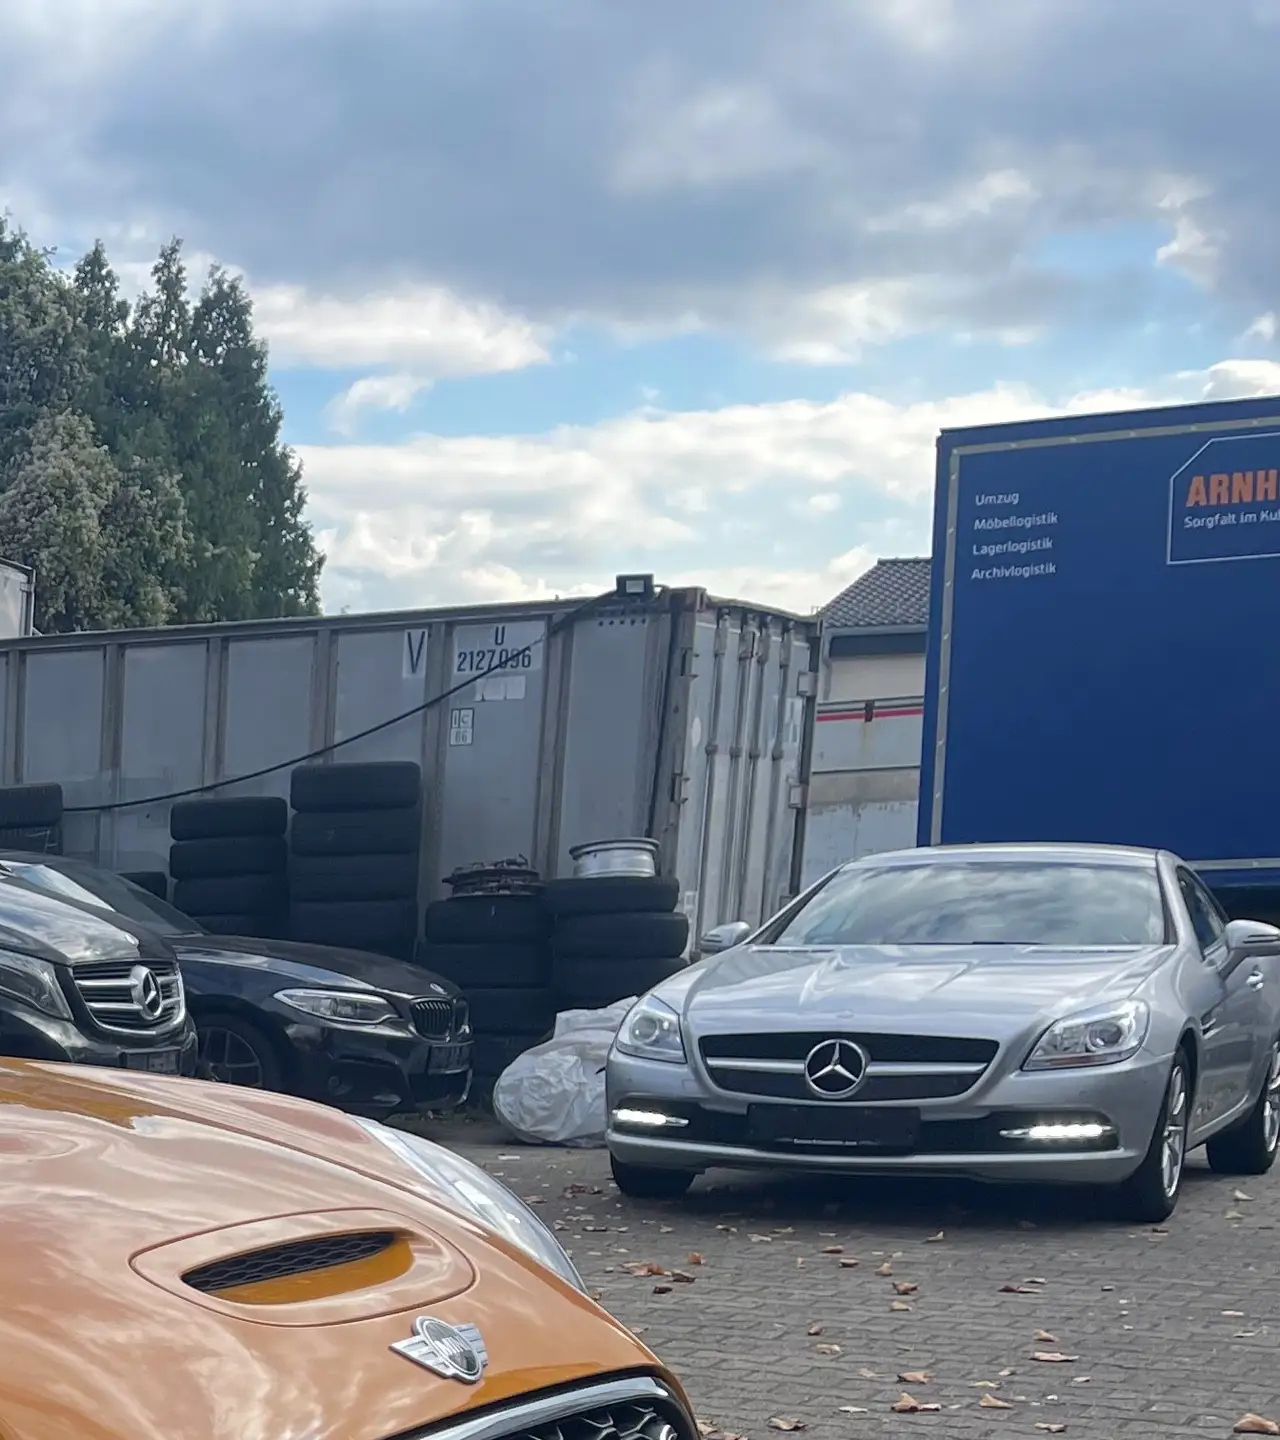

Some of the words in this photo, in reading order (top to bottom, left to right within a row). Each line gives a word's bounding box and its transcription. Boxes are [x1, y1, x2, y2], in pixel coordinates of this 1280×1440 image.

[975, 492, 1020, 506] Umzug
[973, 511, 1059, 531] Möbellogistik
[1183, 512, 1237, 529] Sorgfalt
[1239, 511, 1257, 524] im
[972, 536, 1053, 557] Lagerlogistik
[970, 561, 1057, 580] Archivlogistik
[494, 626, 506, 646] U
[407, 630, 426, 674] V
